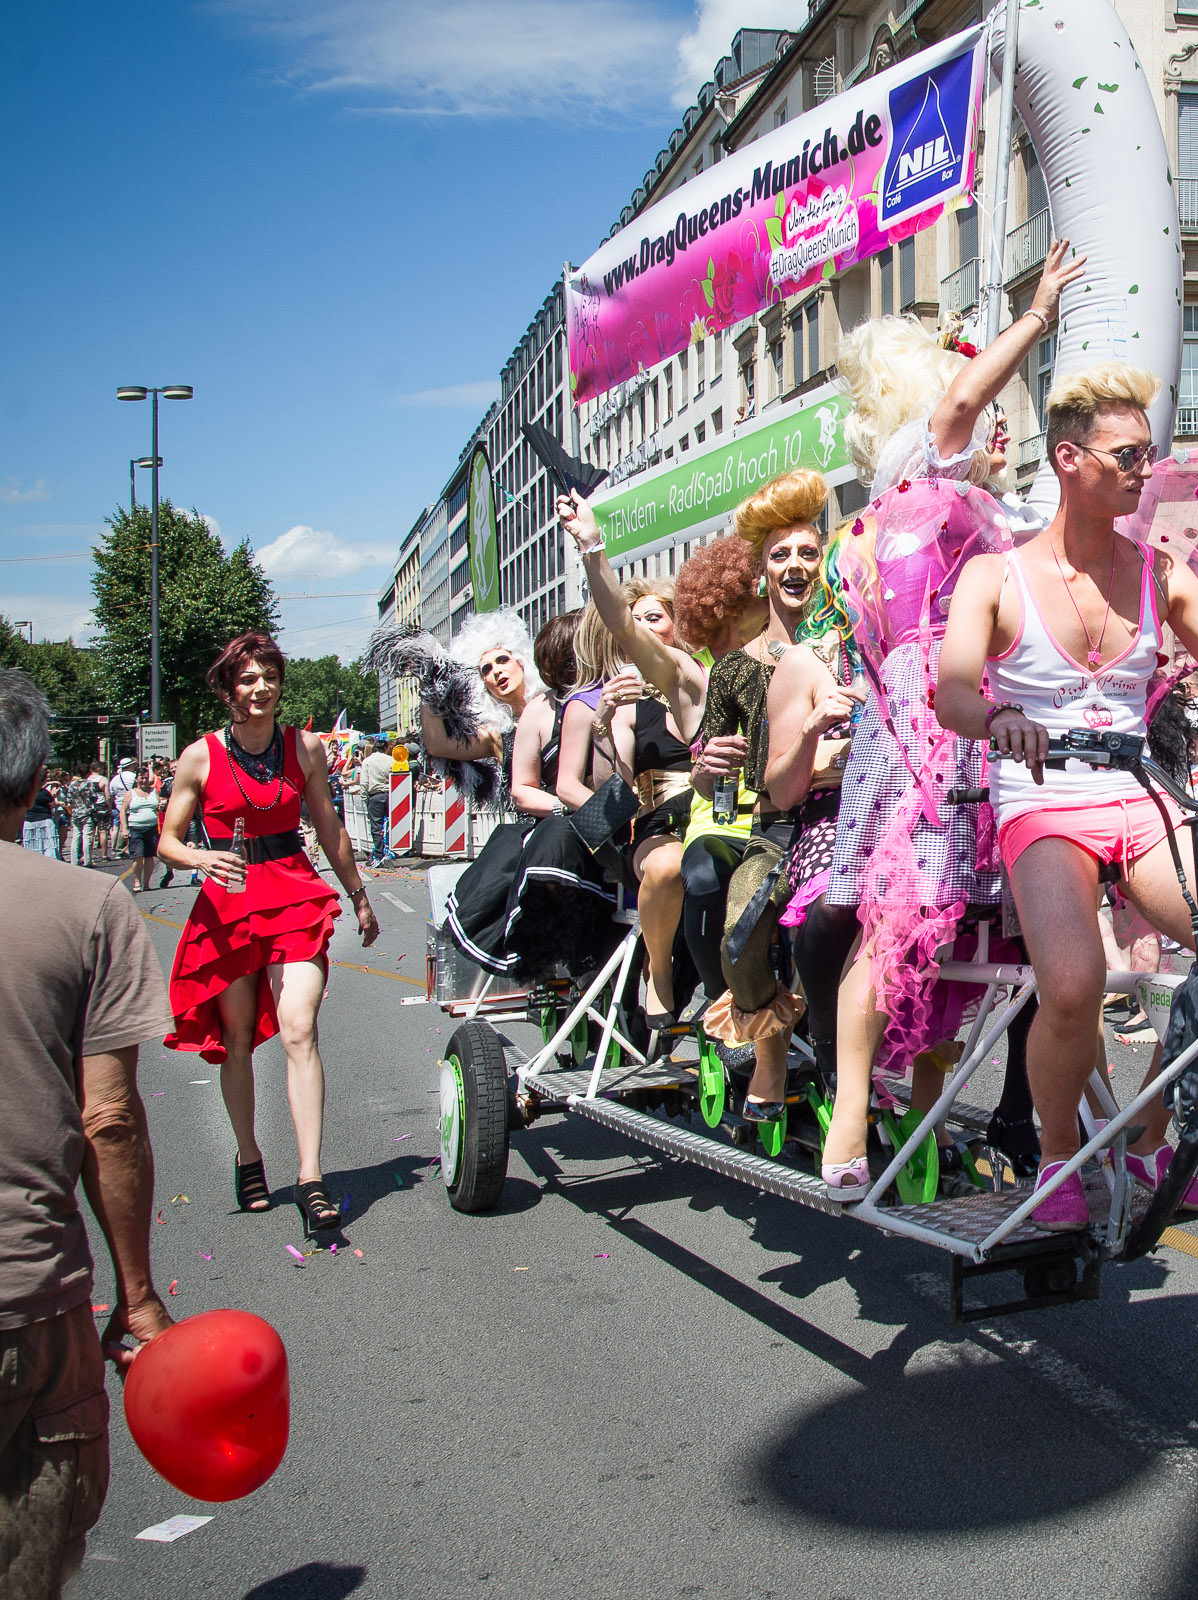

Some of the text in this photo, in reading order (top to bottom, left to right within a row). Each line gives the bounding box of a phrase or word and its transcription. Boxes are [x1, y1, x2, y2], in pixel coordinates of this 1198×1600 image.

[942, 168, 954, 182] Bar
[603, 109, 883, 297] www.DragQueens-Munich.de
[788, 206, 805, 232] Join
[807, 202, 820, 222] the
[771, 217, 857, 280] #DragQueensMunich
[608, 497, 657, 542] TENdem
[669, 456, 734, 517] RadlSpaß
[736, 437, 777, 488] hoch
[784, 430, 802, 470] 10
[1053, 676, 1089, 709] Pink
[1096, 675, 1137, 692] Prince
